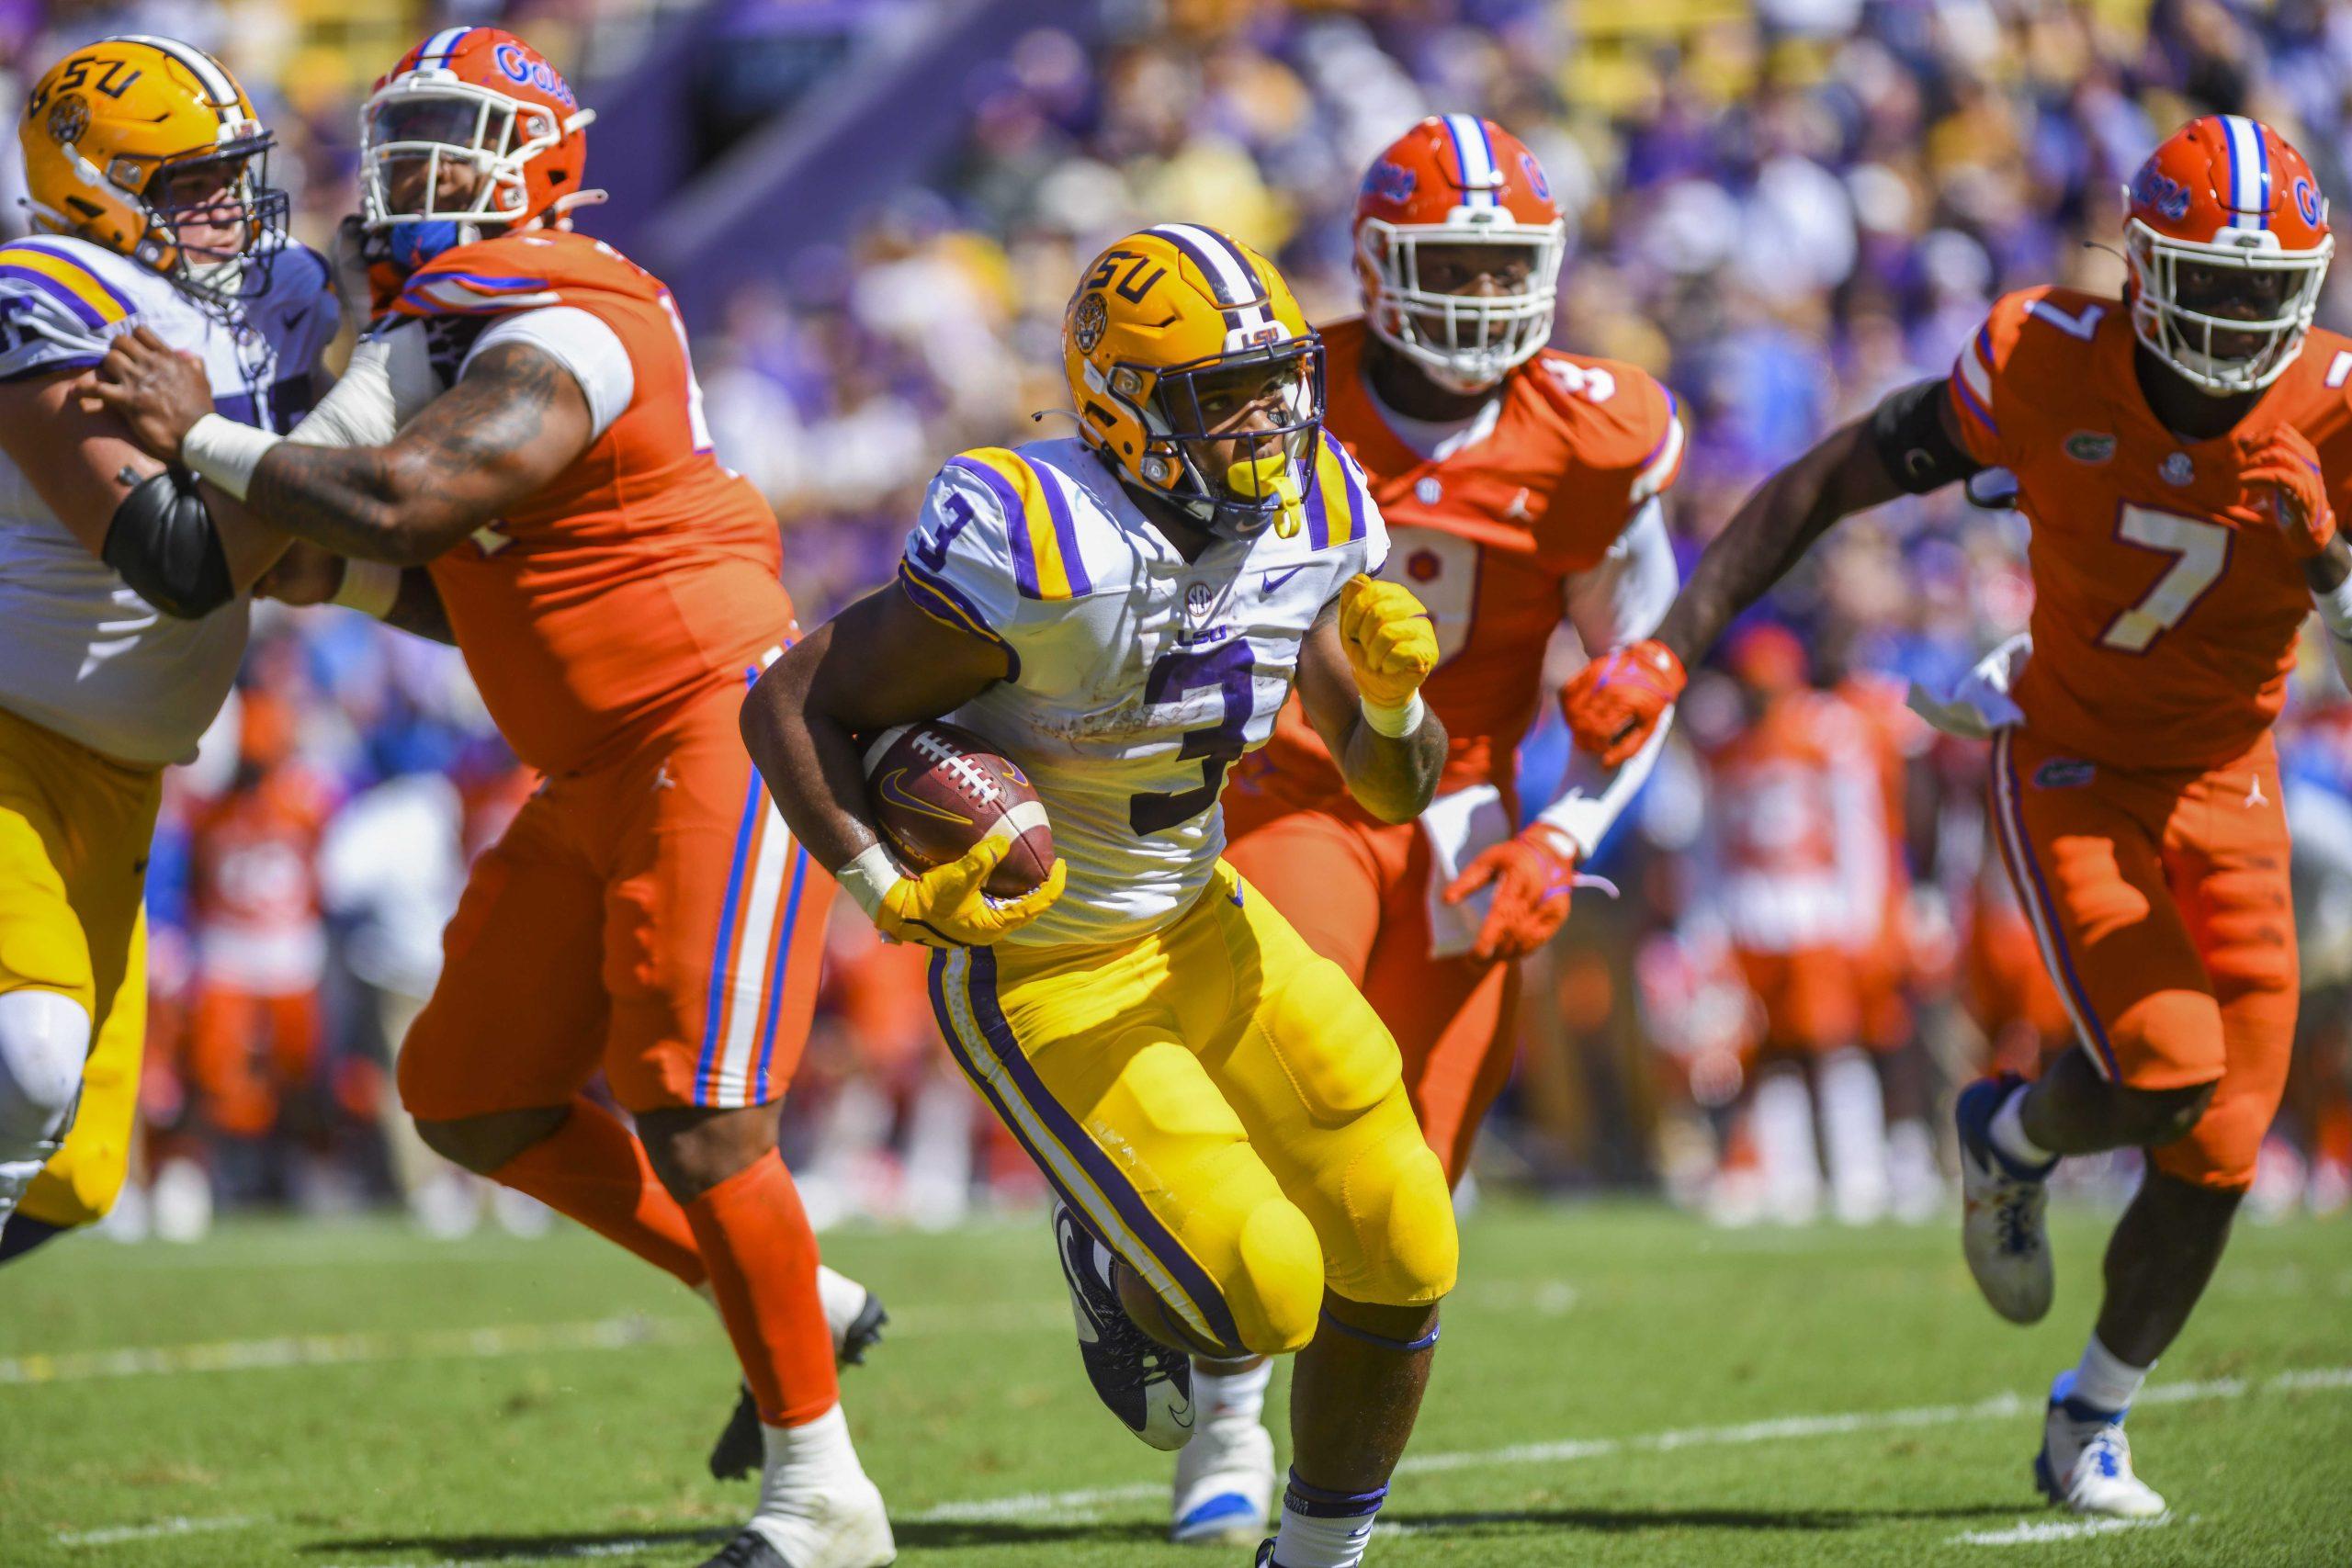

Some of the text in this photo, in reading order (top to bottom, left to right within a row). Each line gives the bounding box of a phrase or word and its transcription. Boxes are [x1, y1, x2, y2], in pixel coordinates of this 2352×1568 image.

[1073, 250, 1168, 305] SU
[1240, 326, 1279, 350] LSU
[915, 491, 975, 574] 3
[1188, 583, 1212, 615] SEC
[2092, 498, 2236, 657] 7
[1177, 624, 1227, 647] LSU
[1129, 637, 1256, 837] 3
